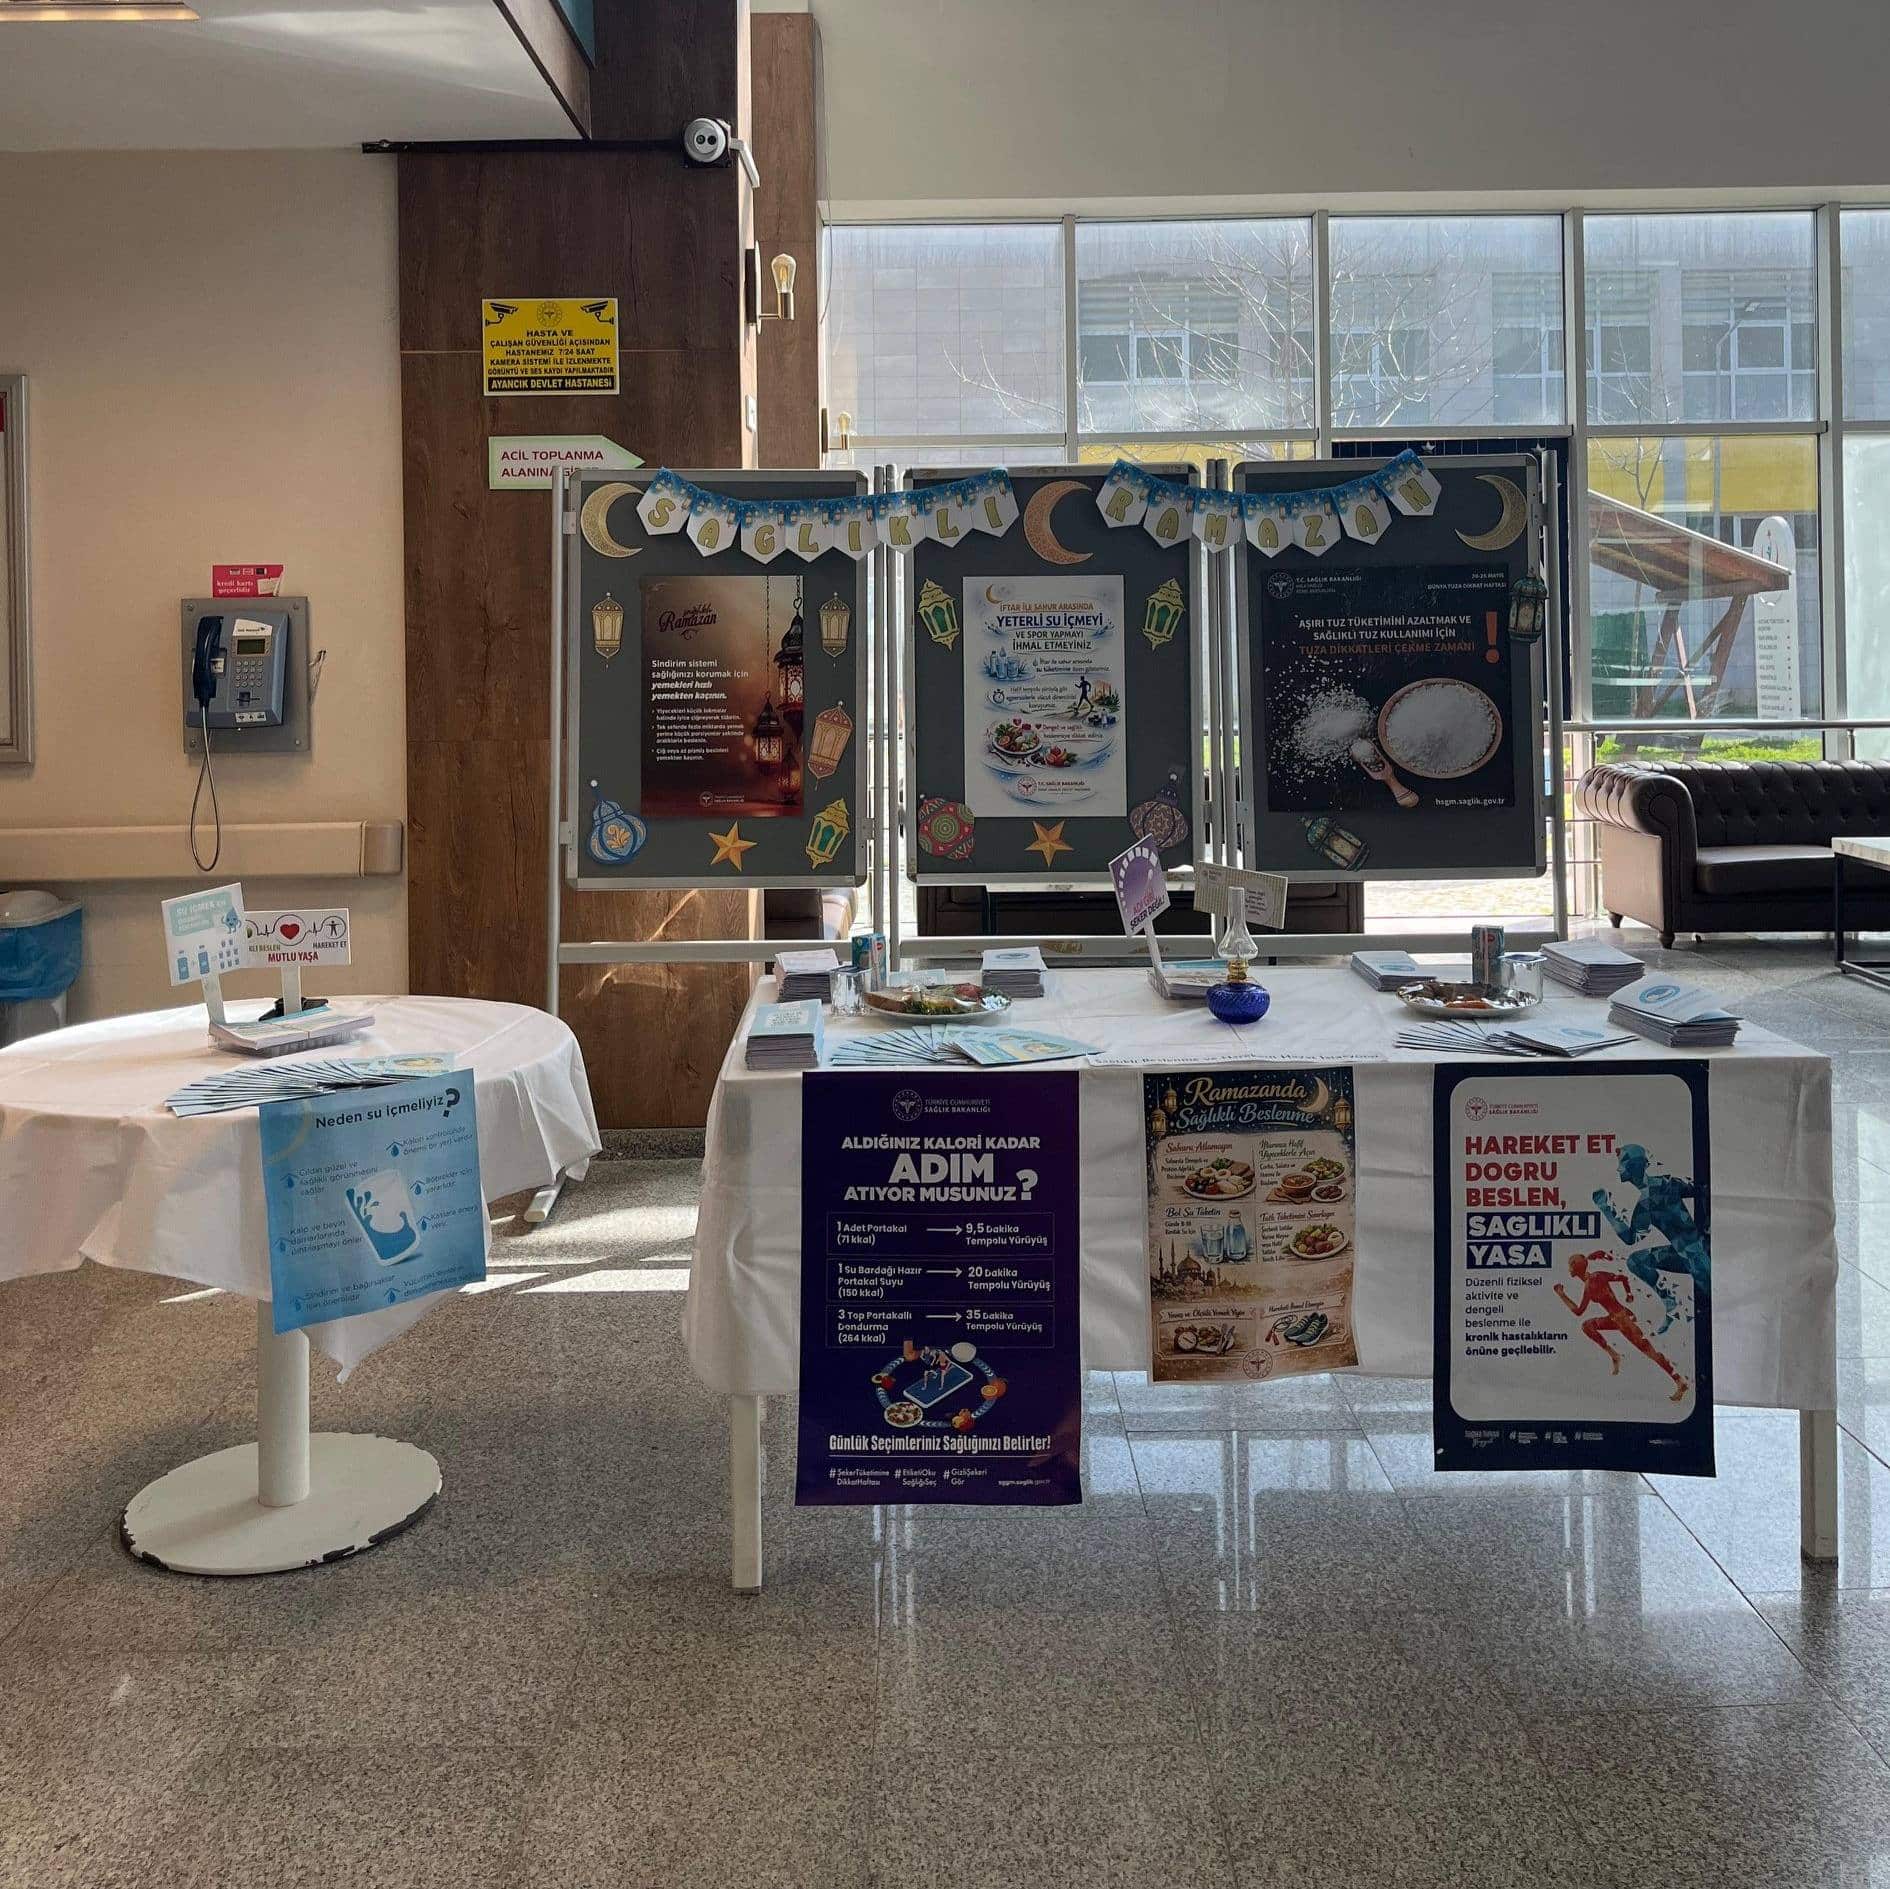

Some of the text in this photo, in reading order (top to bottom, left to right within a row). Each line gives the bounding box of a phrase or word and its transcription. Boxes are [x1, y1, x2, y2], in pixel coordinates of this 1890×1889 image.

[569, 338, 610, 348] AÇISINDAN
[490, 358, 521, 366] KAMERA
[523, 357, 551, 365] SİSTEMİ
[491, 378, 612, 389] AYANCIK DEVLET HASTANESİ
[501, 450, 604, 461] ACİL TOPLANMA
[1105, 478, 1432, 548] RAMAZAN
[1034, 603, 1057, 611] SAHUR
[1058, 602, 1094, 610] ARASINDA
[658, 610, 718, 632] Ramazan
[996, 613, 1103, 629] YETERLİ SU İÇMEYİ
[1298, 615, 1472, 630] AŞIRI TUZ TÜKETİMİNİ AZALTMAK VE
[1015, 631, 1025, 639] VE
[1027, 631, 1048, 639] SPOR
[1312, 627, 1456, 641] SAĞLIKLI TUZ KULLANIMI İÇİN
[1012, 639, 1092, 651] İHMAL ETMEYİNİZ
[1298, 641, 1476, 655] TUZA DİKKATLERİ ÇEKME ZAMANI
[651, 659, 718, 668] Sindirim sistemi
[651, 670, 749, 679] sağlığınızı korumak için
[651, 680, 713, 690] yemekleri hızlı
[651, 692, 693, 701] yemekten
[312, 941, 339, 950] HAREKET
[268, 952, 319, 963] MUTLU YAŞA
[1183, 1076, 1308, 1108] Ramazanda
[924, 1105, 991, 1113] SAĞLIK BAKANLIĞI
[315, 1113, 362, 1129] Neden
[366, 1110, 382, 1121] su
[1176, 1103, 1315, 1132] Sağlıklı Beslenme
[841, 1134, 1041, 1150] ALDIĞINIZ KALORİ KADAR
[1465, 1134, 1622, 1157] HAREKET ET,
[888, 1152, 994, 1184] ADIM
[844, 1186, 916, 1201] ATIYOR
[1466, 1187, 1567, 1210] BESLEN,
[1165, 1207, 1181, 1218] Bol
[1182, 1206, 1194, 1218] Su
[843, 1224, 865, 1233] Adet
[867, 1224, 907, 1233] Portakal
[965, 1223, 985, 1235] 9,5
[986, 1225, 1019, 1234] Dakika
[836, 1234, 876, 1246] (71 kkal)
[966, 1236, 1048, 1247] Tempolu Yürüyüş
[844, 1266, 857, 1275] Su
[858, 1265, 896, 1277] Bardağı
[897, 1266, 922, 1275] Hazır
[968, 1266, 983, 1277] 20
[985, 1268, 1018, 1277] Dakika
[837, 1277, 904, 1288] Portakal Suyu
[968, 1280, 1051, 1291] Tempolu Yürüyüş
[1465, 1277, 1542, 1287] Düzenli fiziksel
[837, 1287, 884, 1299] (150 kkal)
[1465, 1291, 1503, 1301] aktivite
[837, 1310, 1014, 1321] 3 Top Portakallı 35 Dakika
[1465, 1304, 1504, 1316] dengeli
[837, 1322, 889, 1332] Dondurma
[966, 1322, 1043, 1333] Tempolu Yürüyüş
[1465, 1318, 1531, 1328] beslenme ile
[837, 1333, 886, 1344] (264 kkal)
[1465, 1331, 1568, 1342] kronik hastalıkların
[1465, 1346, 1556, 1357] önüne geçilebilir.
[829, 1435, 1052, 1455] Günlük Seçimleriniz Sağlığınızı Belirler!
